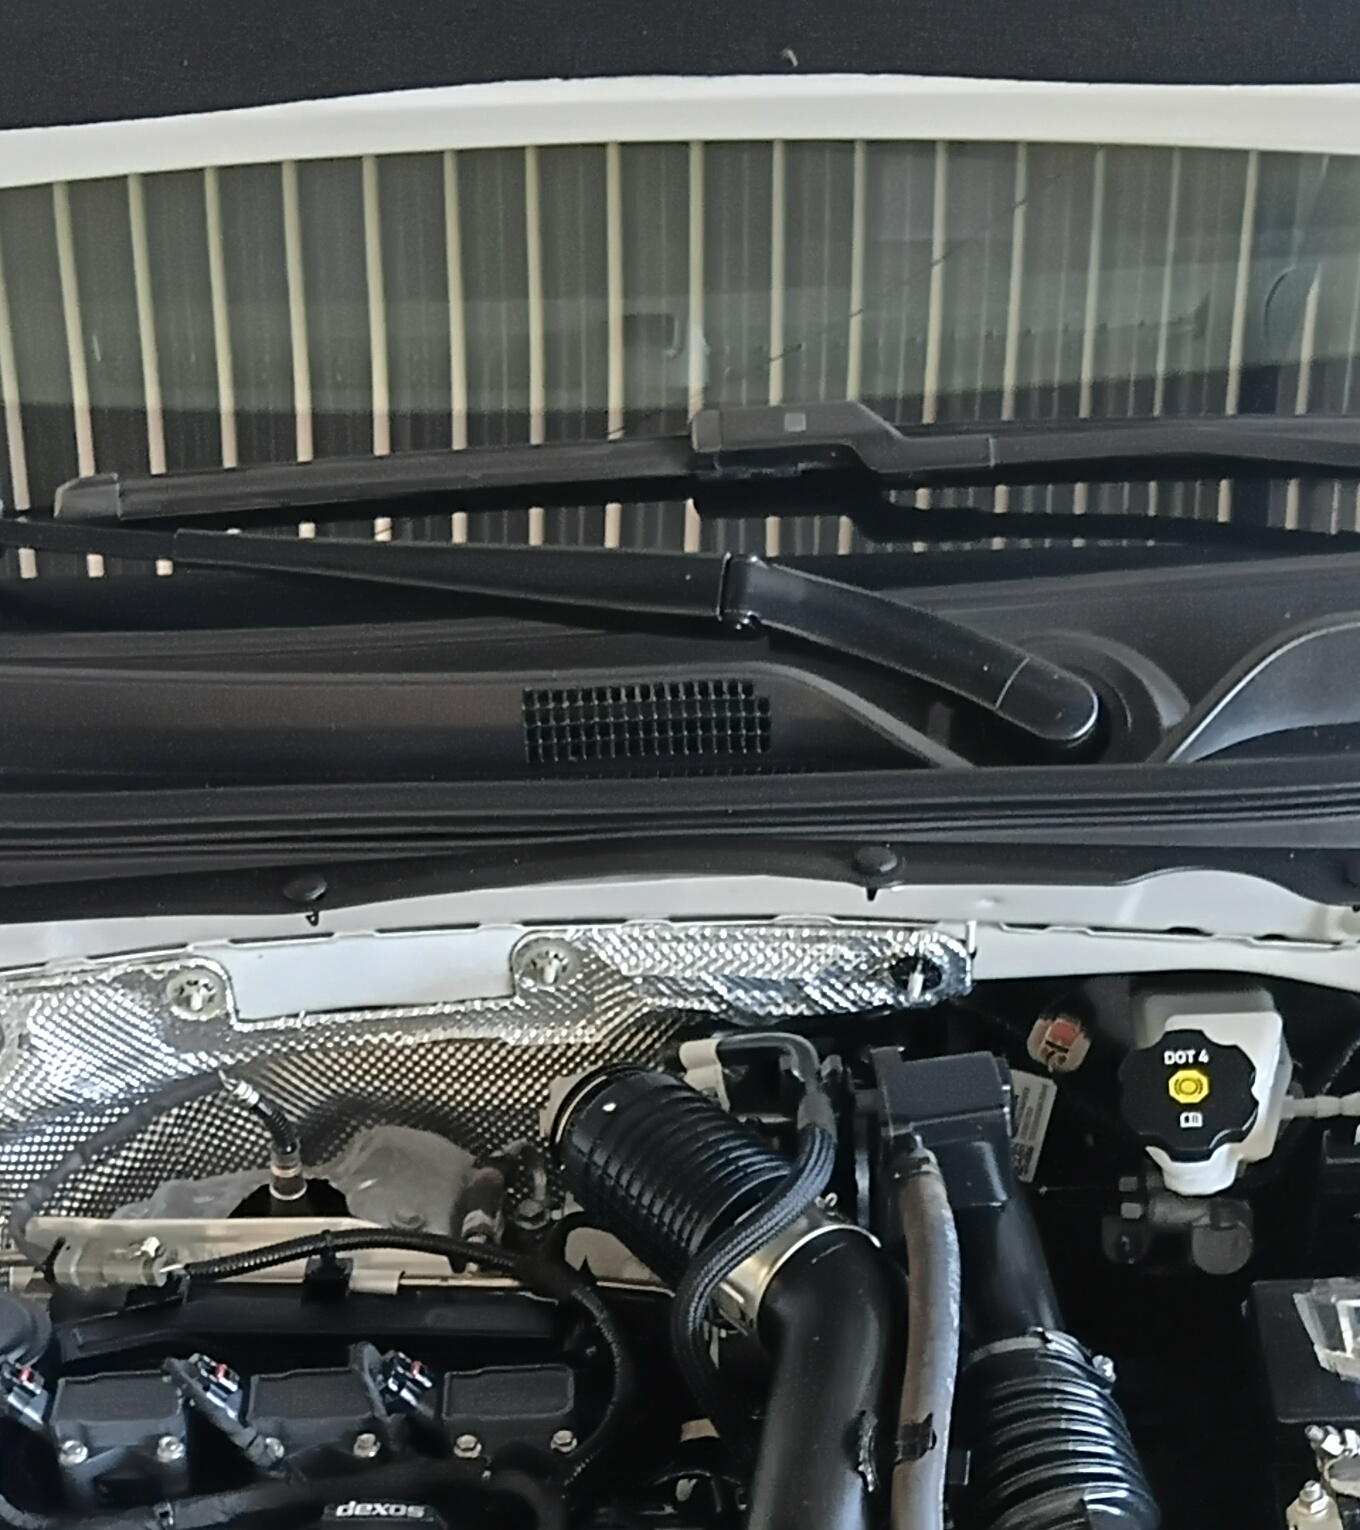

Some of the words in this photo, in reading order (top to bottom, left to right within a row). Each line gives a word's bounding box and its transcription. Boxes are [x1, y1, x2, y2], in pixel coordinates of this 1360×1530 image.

[1164, 1048, 1196, 1065] DOT
[1198, 1048, 1209, 1064] 4
[336, 1500, 425, 1518] dexos
